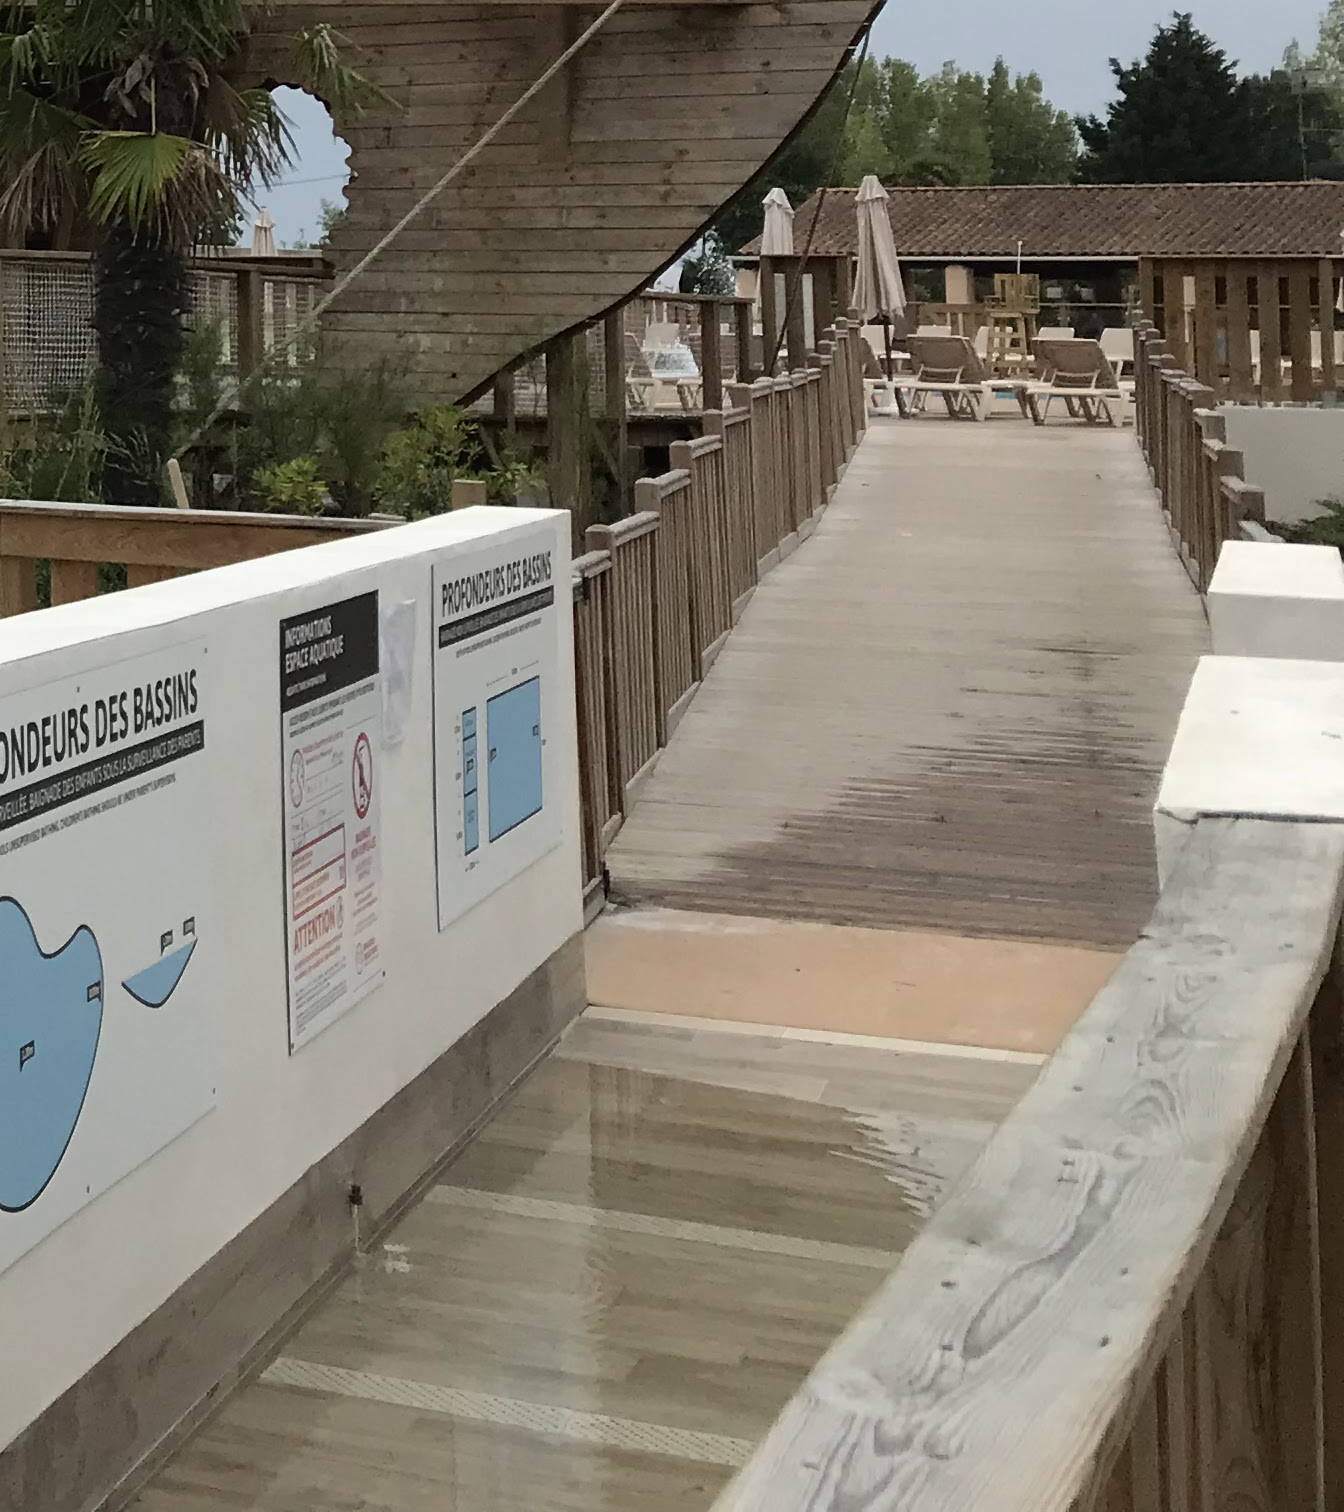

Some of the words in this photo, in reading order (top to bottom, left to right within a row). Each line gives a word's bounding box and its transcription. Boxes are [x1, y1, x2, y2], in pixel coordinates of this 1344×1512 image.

[442, 566, 505, 618] PROFONDEURS
[507, 560, 521, 595] DES
[523, 550, 551, 589] BASSINS
[285, 647, 309, 674] ESPACE
[309, 634, 344, 665] AQUATIQUE
[95, 691, 129, 748] DES
[134, 669, 198, 734] BASSINS
[29, 782, 61, 811] BAIGNADE
[62, 776, 74, 798] DES
[75, 766, 101, 793] ENFANTS
[102, 760, 118, 782] SOUS
[119, 756, 126, 775] LA
[294, 904, 336, 955] ATTENTION
